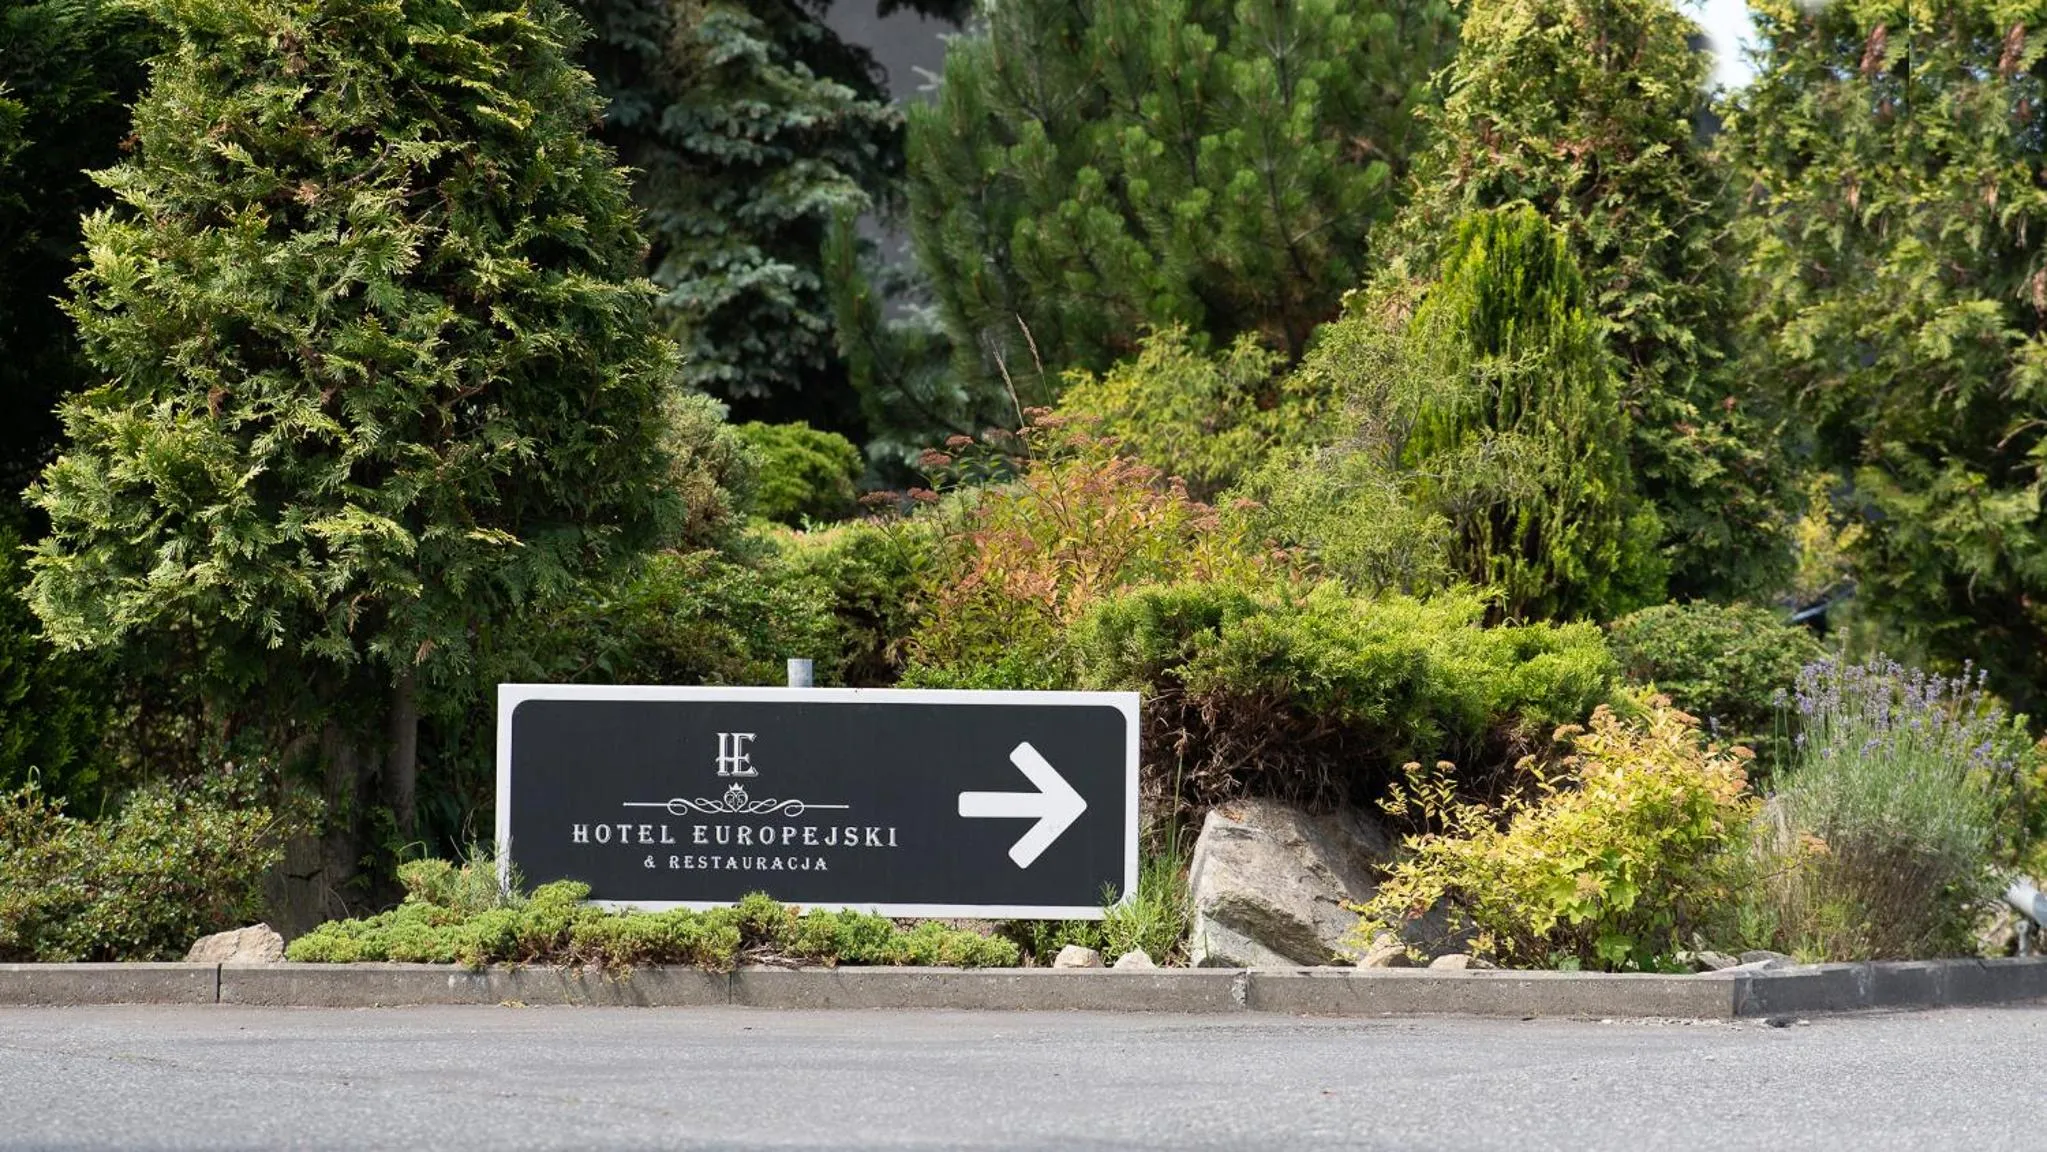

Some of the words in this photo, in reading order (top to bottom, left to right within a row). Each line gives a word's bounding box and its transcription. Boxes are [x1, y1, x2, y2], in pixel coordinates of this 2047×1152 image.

[572, 823, 676, 844] HOTEL
[692, 824, 898, 847] EUROPEJSKI
[643, 855, 656, 869] &
[669, 855, 828, 871] RESTAURACJA
